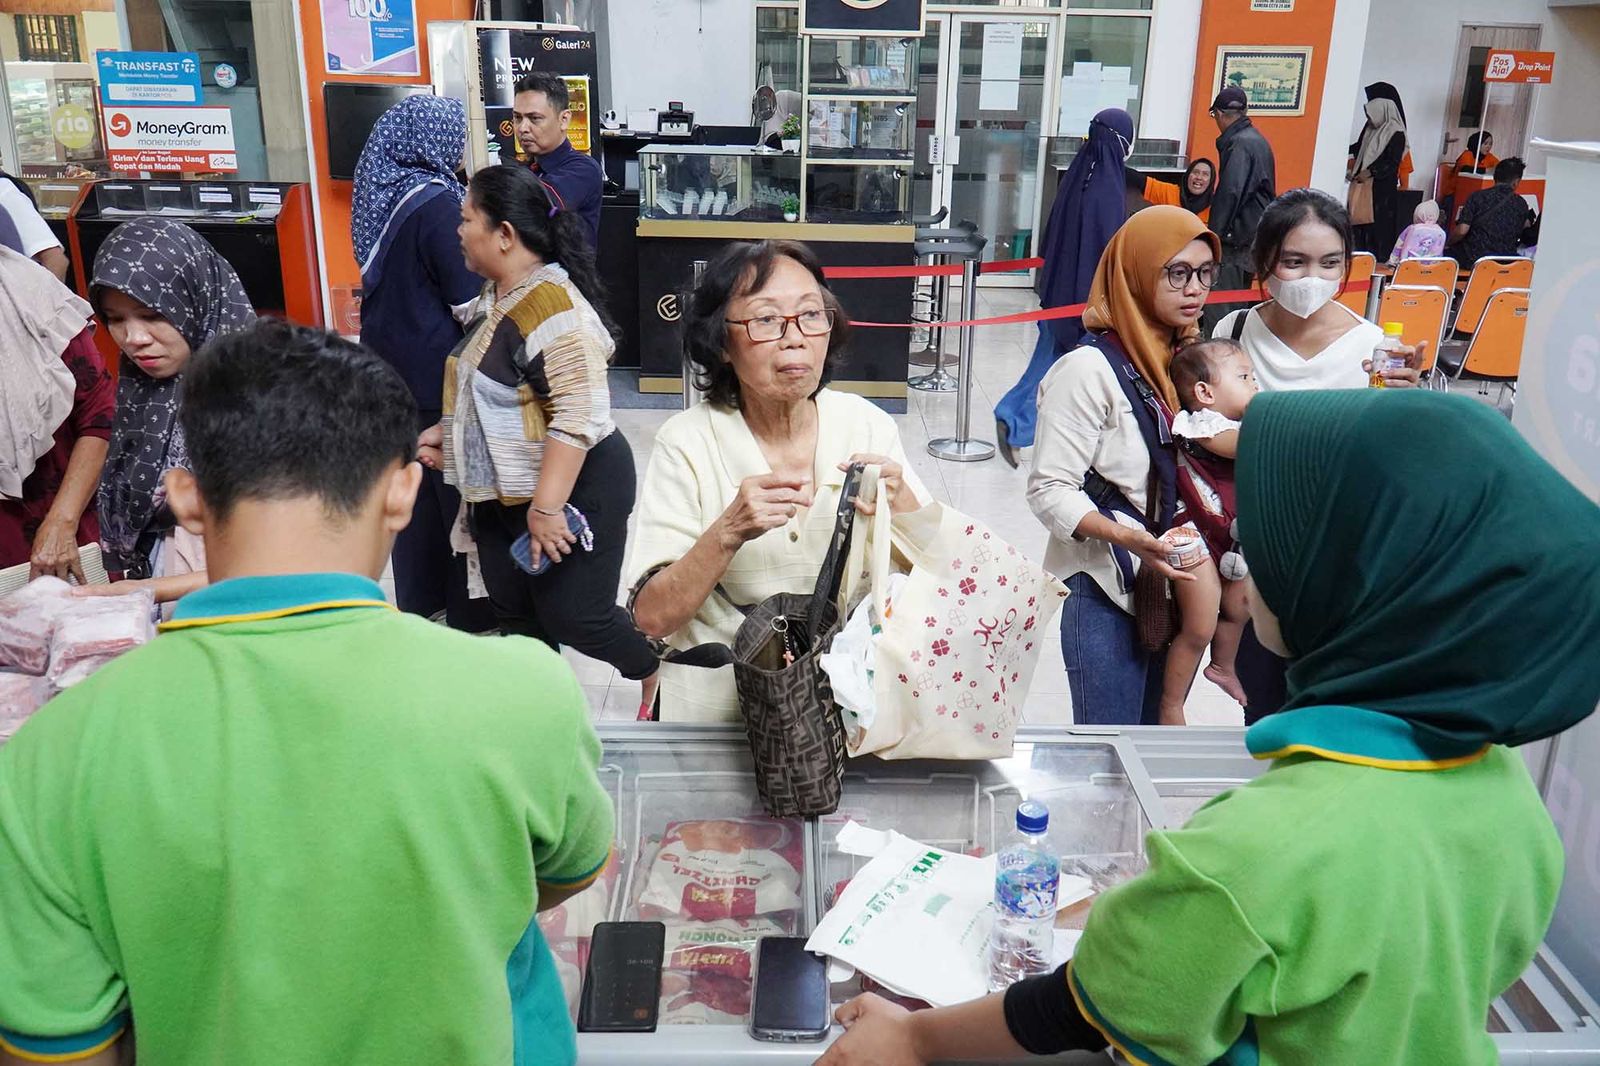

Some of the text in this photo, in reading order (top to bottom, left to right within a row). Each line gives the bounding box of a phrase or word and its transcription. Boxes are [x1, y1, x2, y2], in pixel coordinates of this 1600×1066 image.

[494, 57, 534, 71] NEW
[1493, 56, 1509, 66] Pos
[1518, 62, 1551, 70] Drop Point
[115, 62, 179, 72] TRANSFAST
[1491, 66, 1509, 76] Aja!
[496, 74, 527, 83] PROD
[56, 110, 89, 132] ria
[137, 121, 226, 137] MoneyGram
[168, 138, 202, 146] transfer
[140, 154, 156, 162] dan
[185, 156, 205, 164] Uang
